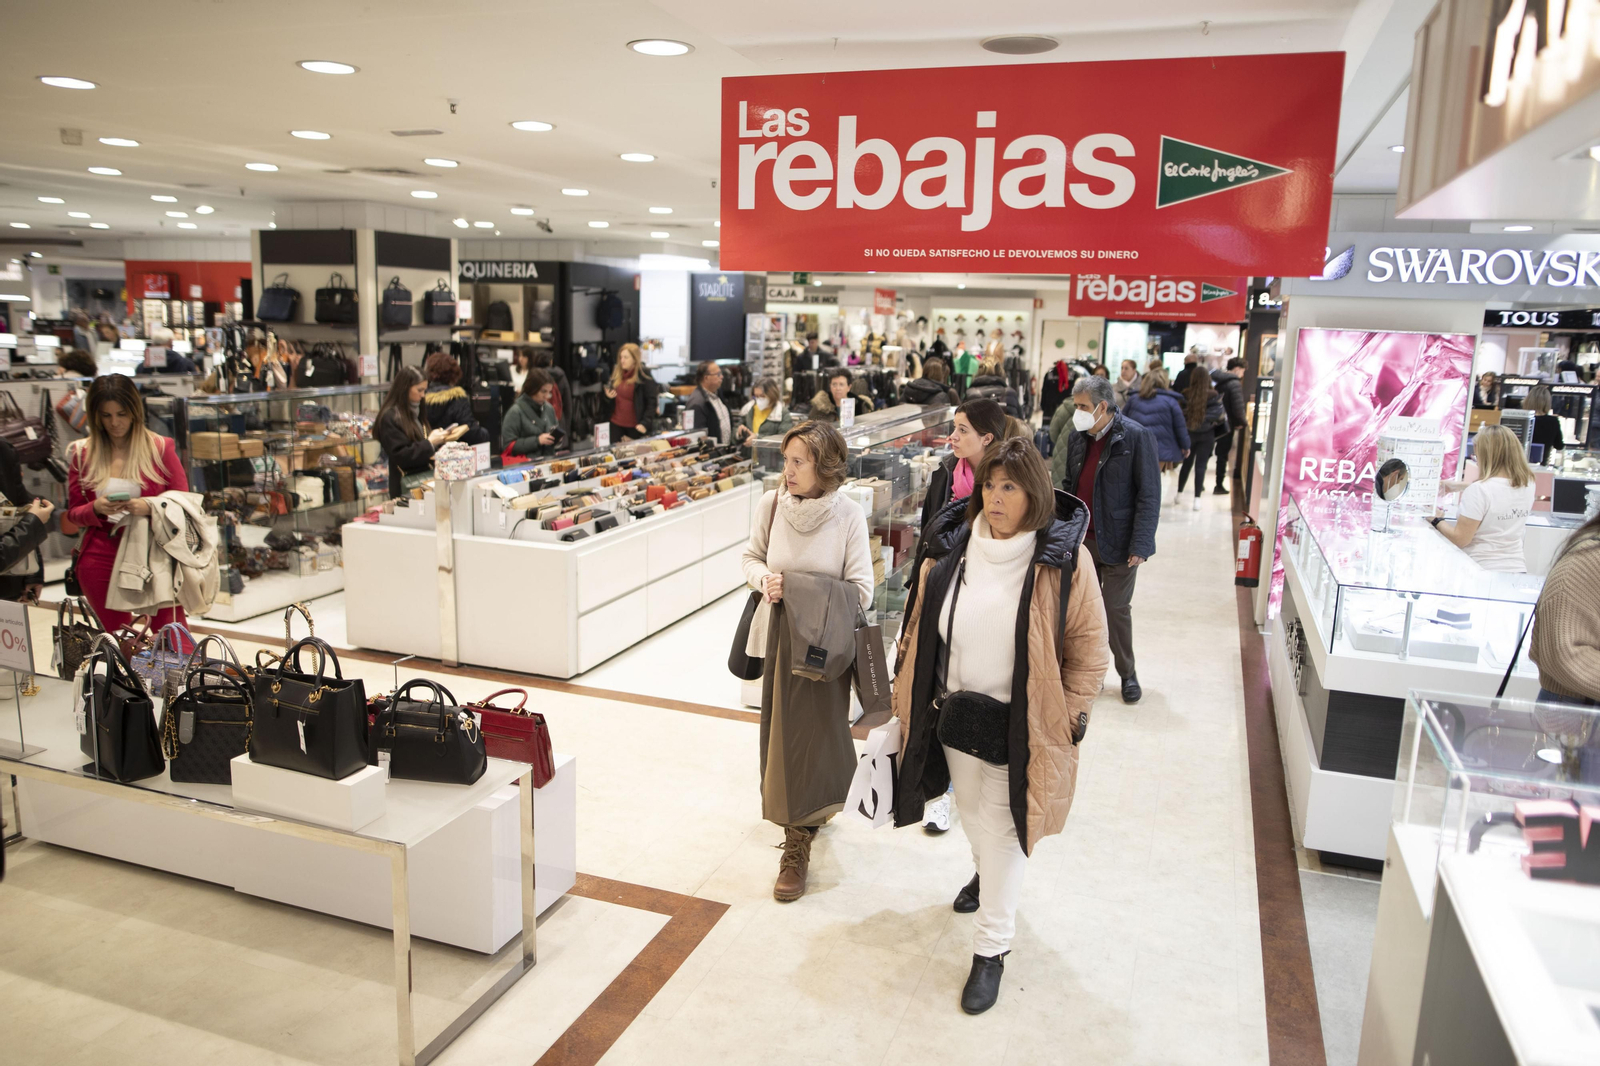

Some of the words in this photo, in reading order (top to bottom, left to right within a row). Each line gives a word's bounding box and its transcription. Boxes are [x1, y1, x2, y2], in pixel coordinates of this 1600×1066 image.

[738, 101, 810, 138] Las
[737, 110, 1137, 232] rebajas
[1164, 162, 1178, 177] El
[1179, 163, 1211, 177] Corte
[1211, 159, 1259, 182] Inglés
[864, 248, 874, 257] SI
[875, 248, 890, 257] NO
[892, 248, 927, 258] QUEDA
[928, 249, 991, 259] SATISFECHO
[993, 249, 1006, 259] LE
[1008, 249, 1078, 260] DEVOLVEMOS
[1080, 250, 1095, 260] SU
[1097, 250, 1139, 260] DINERO
[768, 289, 798, 298] CAJA
[1076, 275, 1196, 309] rebajas
[1499, 311, 1560, 326] TOUS
[1, 629, 27, 653] 0%
[866, 643, 879, 696] puntroma.com
